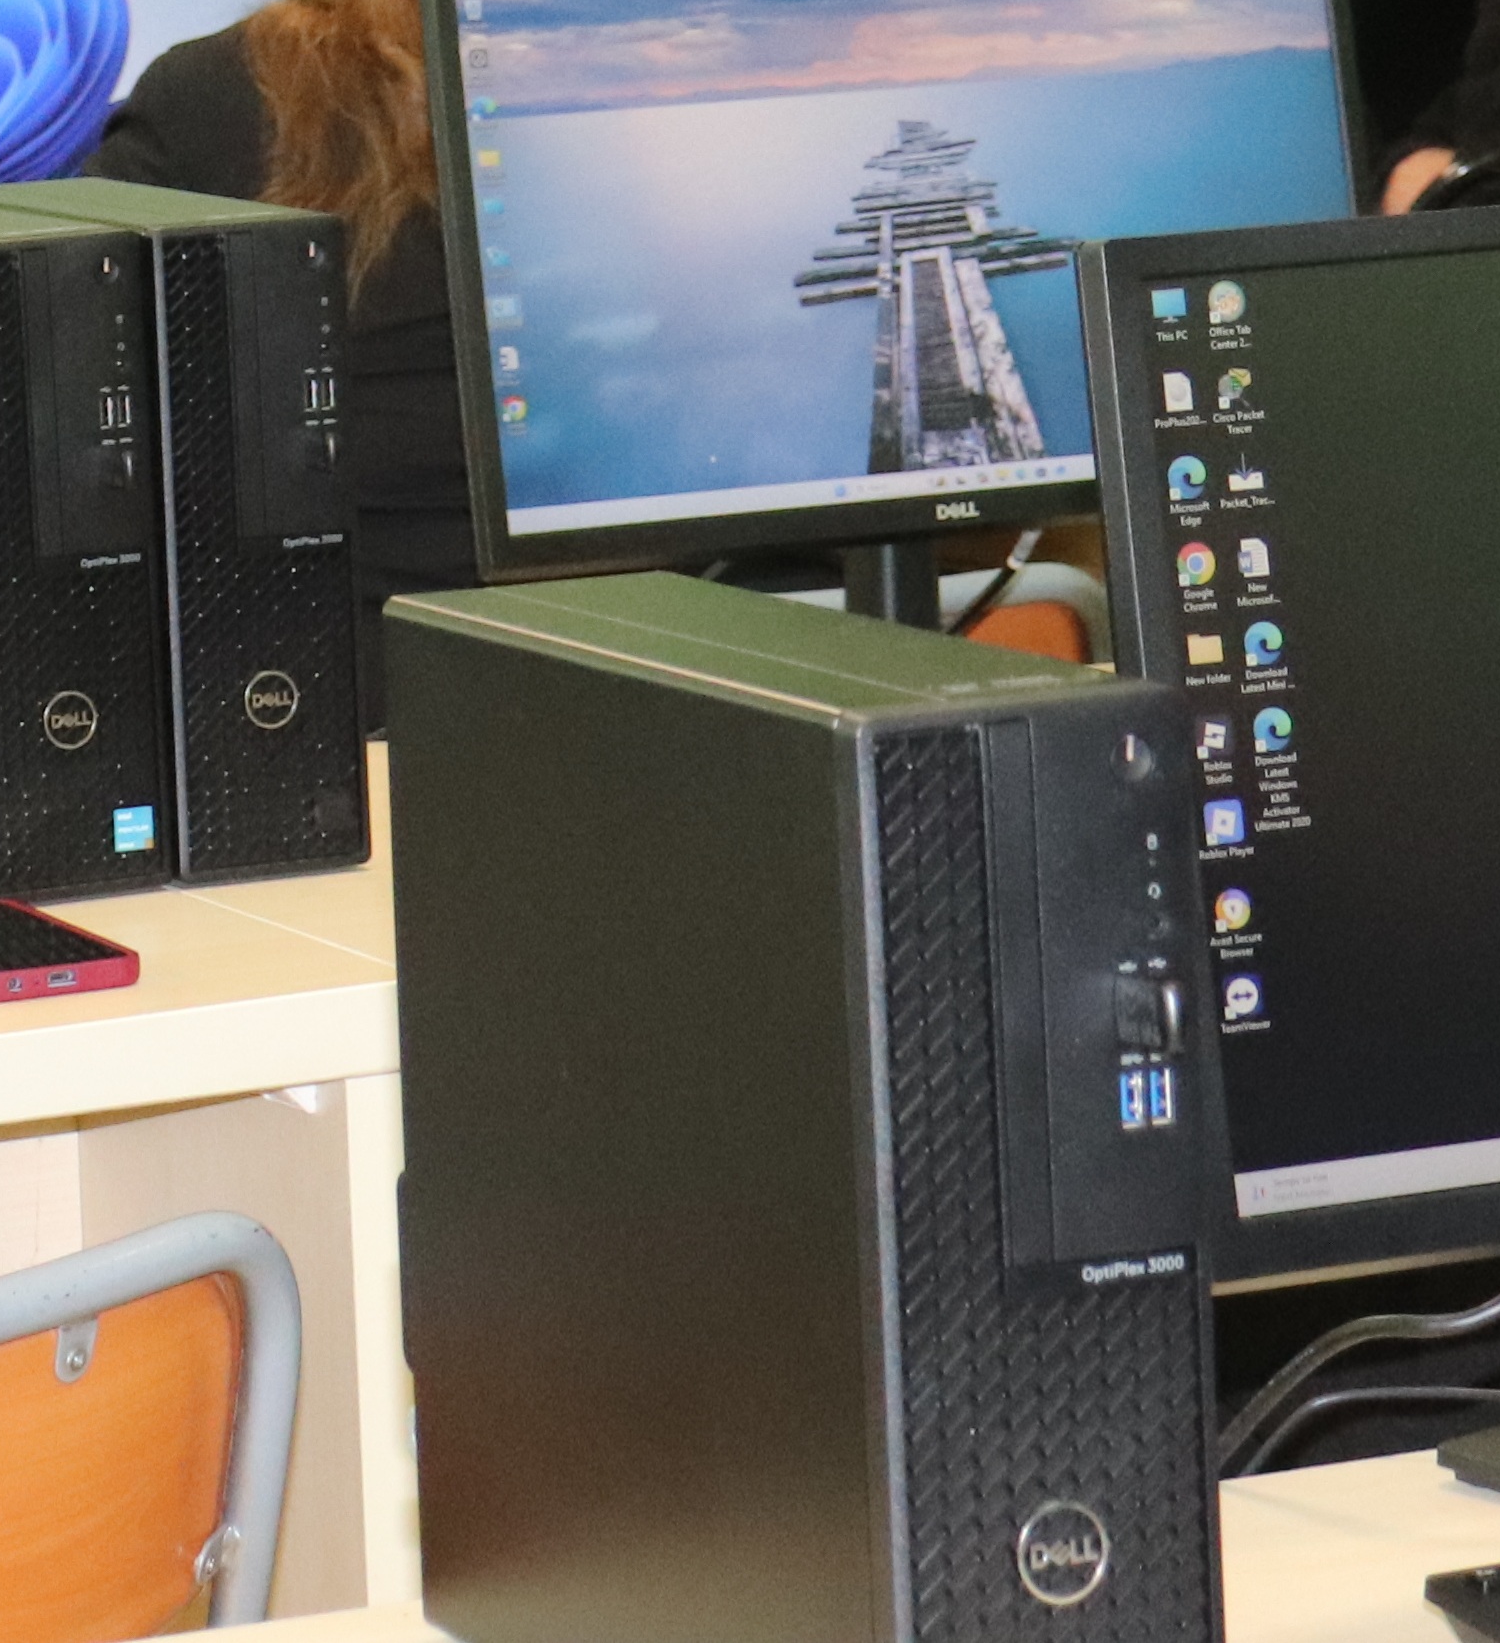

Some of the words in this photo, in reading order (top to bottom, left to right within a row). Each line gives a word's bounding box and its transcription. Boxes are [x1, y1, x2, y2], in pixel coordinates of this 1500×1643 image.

[1156, 331, 1174, 342] This
[1175, 330, 1188, 340] PC
[1209, 326, 1235, 337] Office
[1235, 324, 1252, 335] Tab
[1210, 340, 1238, 350] Center
[1213, 413, 1236, 423] Cisco
[1237, 410, 1265, 421] Packet
[1227, 425, 1253, 434] Tracer
[936, 501, 980, 521] DELL
[1170, 500, 1210, 514] Microsoft
[1180, 516, 1202, 527] Edge
[1183, 588, 1215, 601] Google
[1247, 583, 1268, 593] New
[1183, 602, 1218, 612] Chrome
[1185, 675, 1205, 686] New
[1206, 673, 1232, 684] folder
[1245, 666, 1288, 680] Download
[252, 690, 292, 709] DELL
[51, 710, 92, 730] DELL
[1254, 752, 1297, 767] Download
[1203, 761, 1232, 772] Roblox
[1264, 767, 1289, 778] Latest
[1259, 781, 1298, 792] Windows
[1199, 849, 1228, 860] Roblox
[1229, 846, 1254, 858] Player
[1210, 936, 1233, 947] Avast
[1234, 933, 1263, 944] Secure
[1220, 948, 1254, 959] Browser
[1221, 1020, 1271, 1034] TeamViewer
[1082, 1261, 1145, 1284] OptiPlex
[1147, 1254, 1185, 1274] 3000
[1030, 1536, 1099, 1570] DELL
